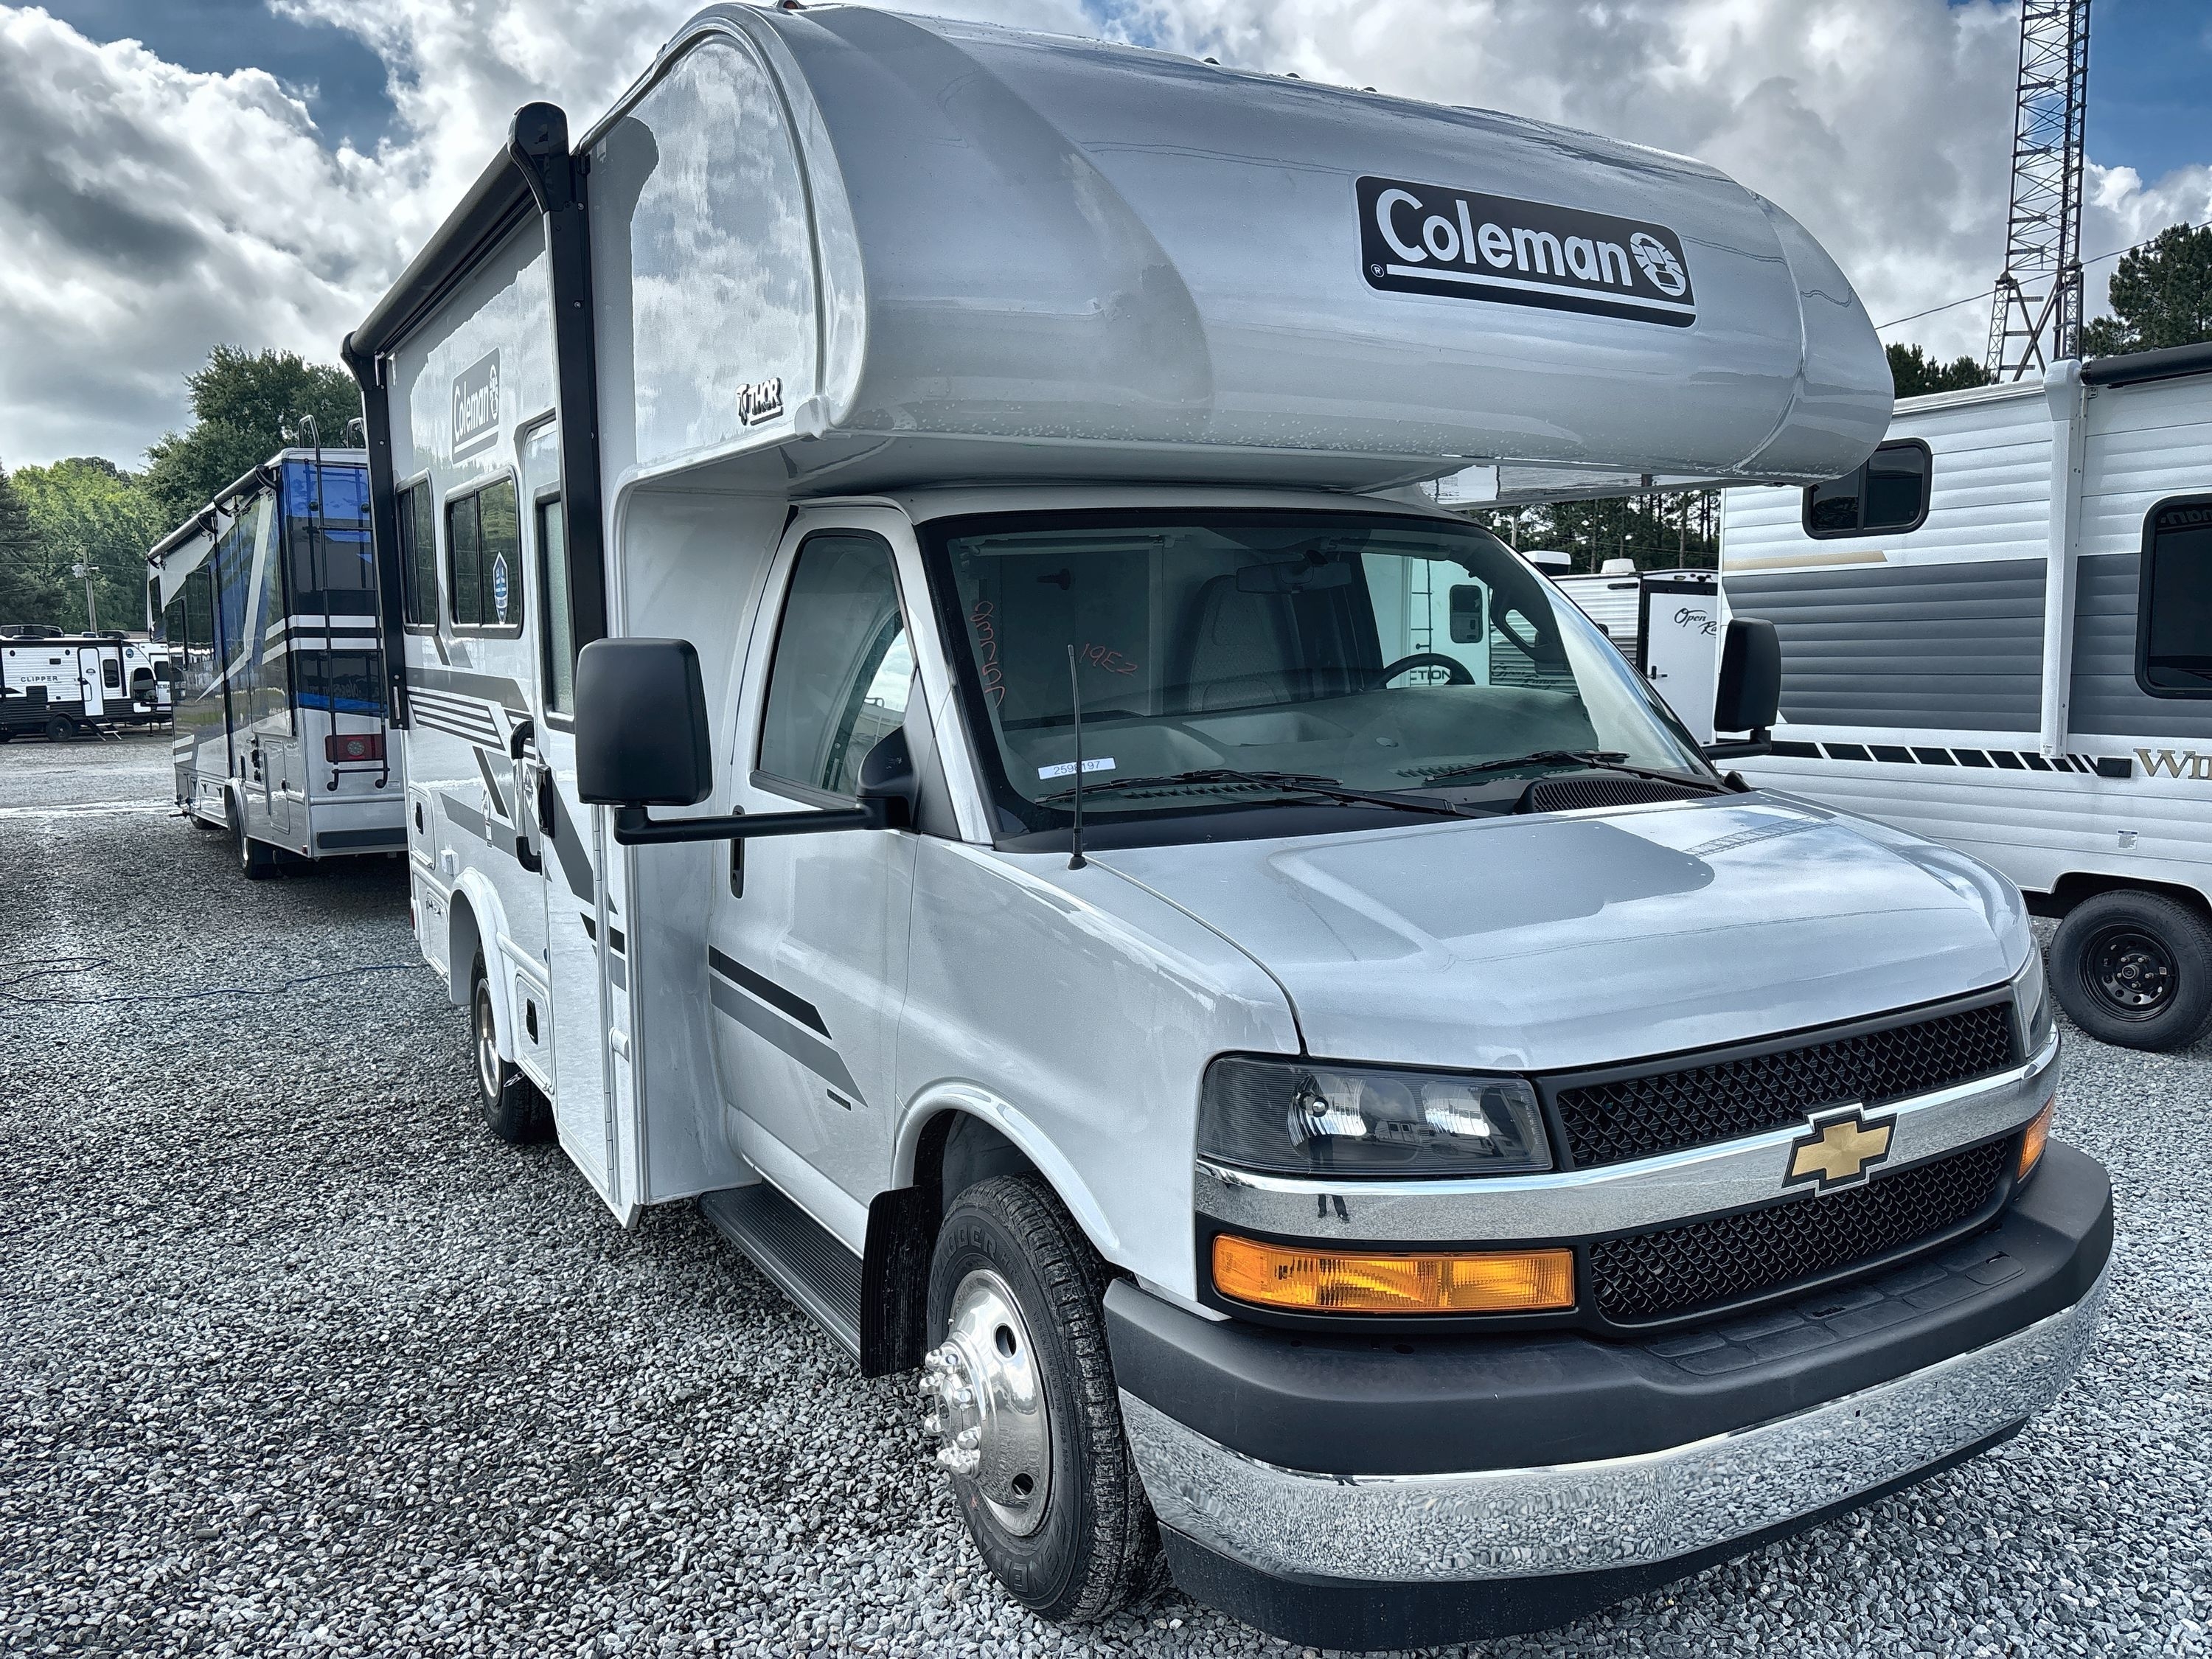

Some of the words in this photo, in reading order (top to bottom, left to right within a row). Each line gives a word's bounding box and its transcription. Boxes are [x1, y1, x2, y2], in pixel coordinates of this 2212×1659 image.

[1376, 188, 1633, 287] Coleman
[453, 381, 489, 442] Coleman
[746, 377, 782, 416] THOR
[1674, 608, 1708, 627] Open
[2133, 748, 2212, 781] WI
